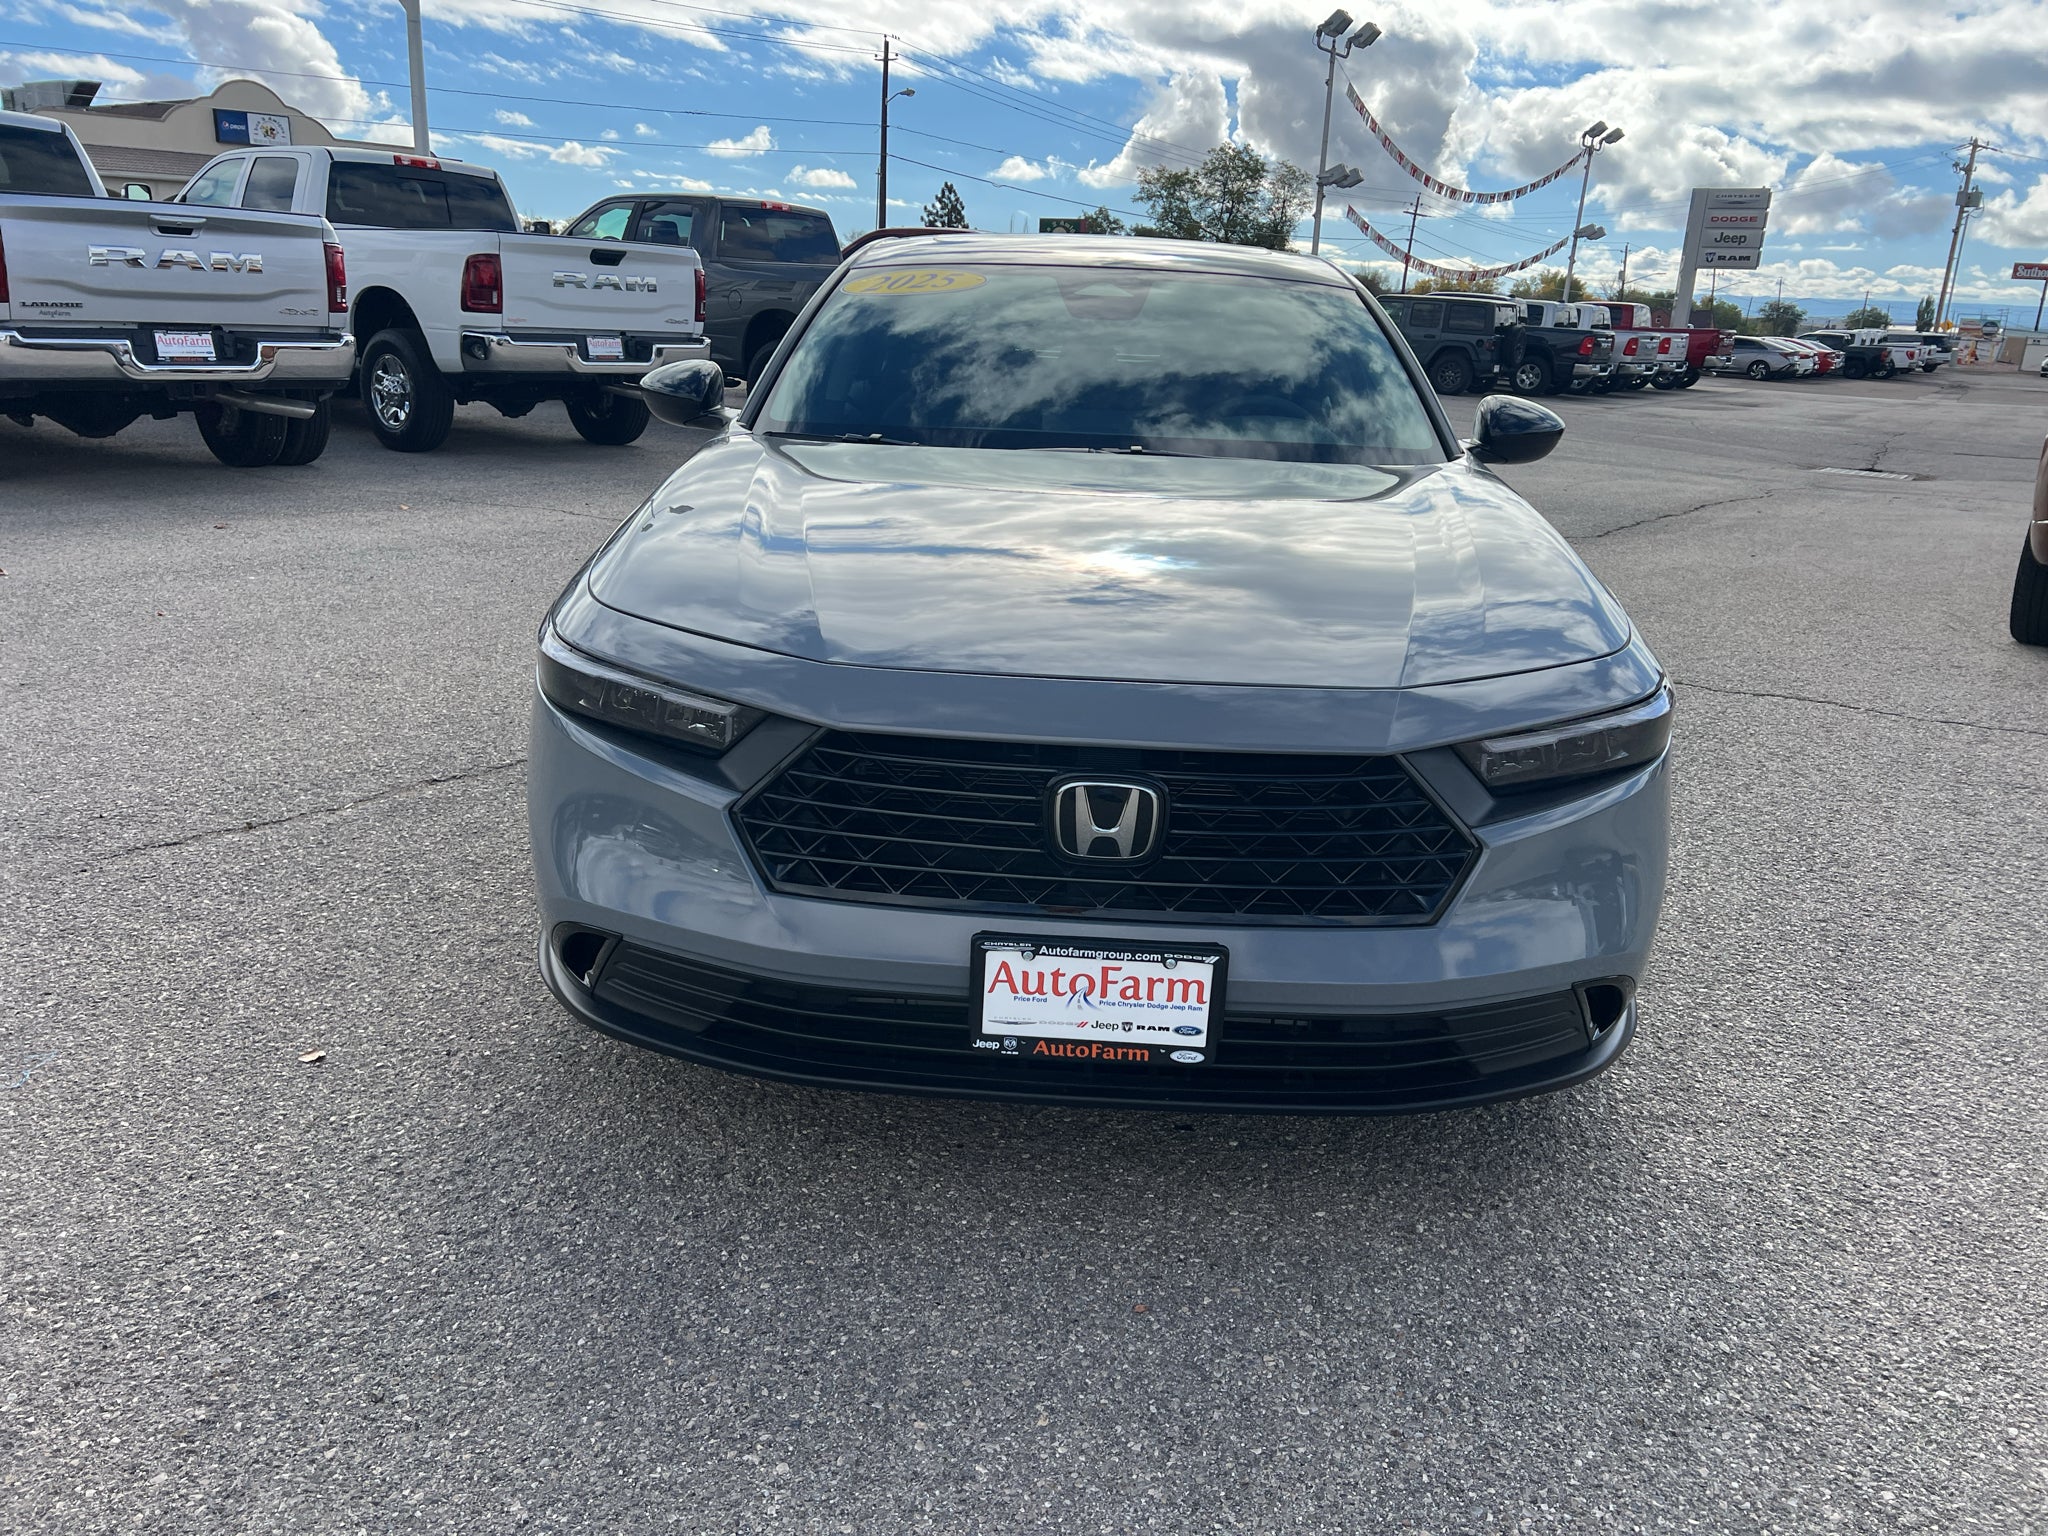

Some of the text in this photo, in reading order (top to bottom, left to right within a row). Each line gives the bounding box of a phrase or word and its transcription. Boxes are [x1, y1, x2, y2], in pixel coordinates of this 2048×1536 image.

[1714, 231, 1747, 245] Jeep
[87, 244, 264, 274] RAM
[552, 270, 657, 293] RAM
[863, 273, 964, 292] 2025
[157, 335, 212, 346] AutoFarm
[1039, 945, 1161, 962] Autofarmgroup.com
[987, 960, 1207, 1005] AutoFarm
[1117, 1001, 1145, 1009] Chrysler
[1147, 1002, 1169, 1010] Dodge
[1091, 1020, 1119, 1032] Jeep
[1136, 1024, 1170, 1032] RAM
[1178, 1027, 1197, 1035] Ford
[972, 1039, 1000, 1050] Jeep
[1032, 1040, 1149, 1062] AutoFarm
[1176, 1051, 1198, 1061] Ford
